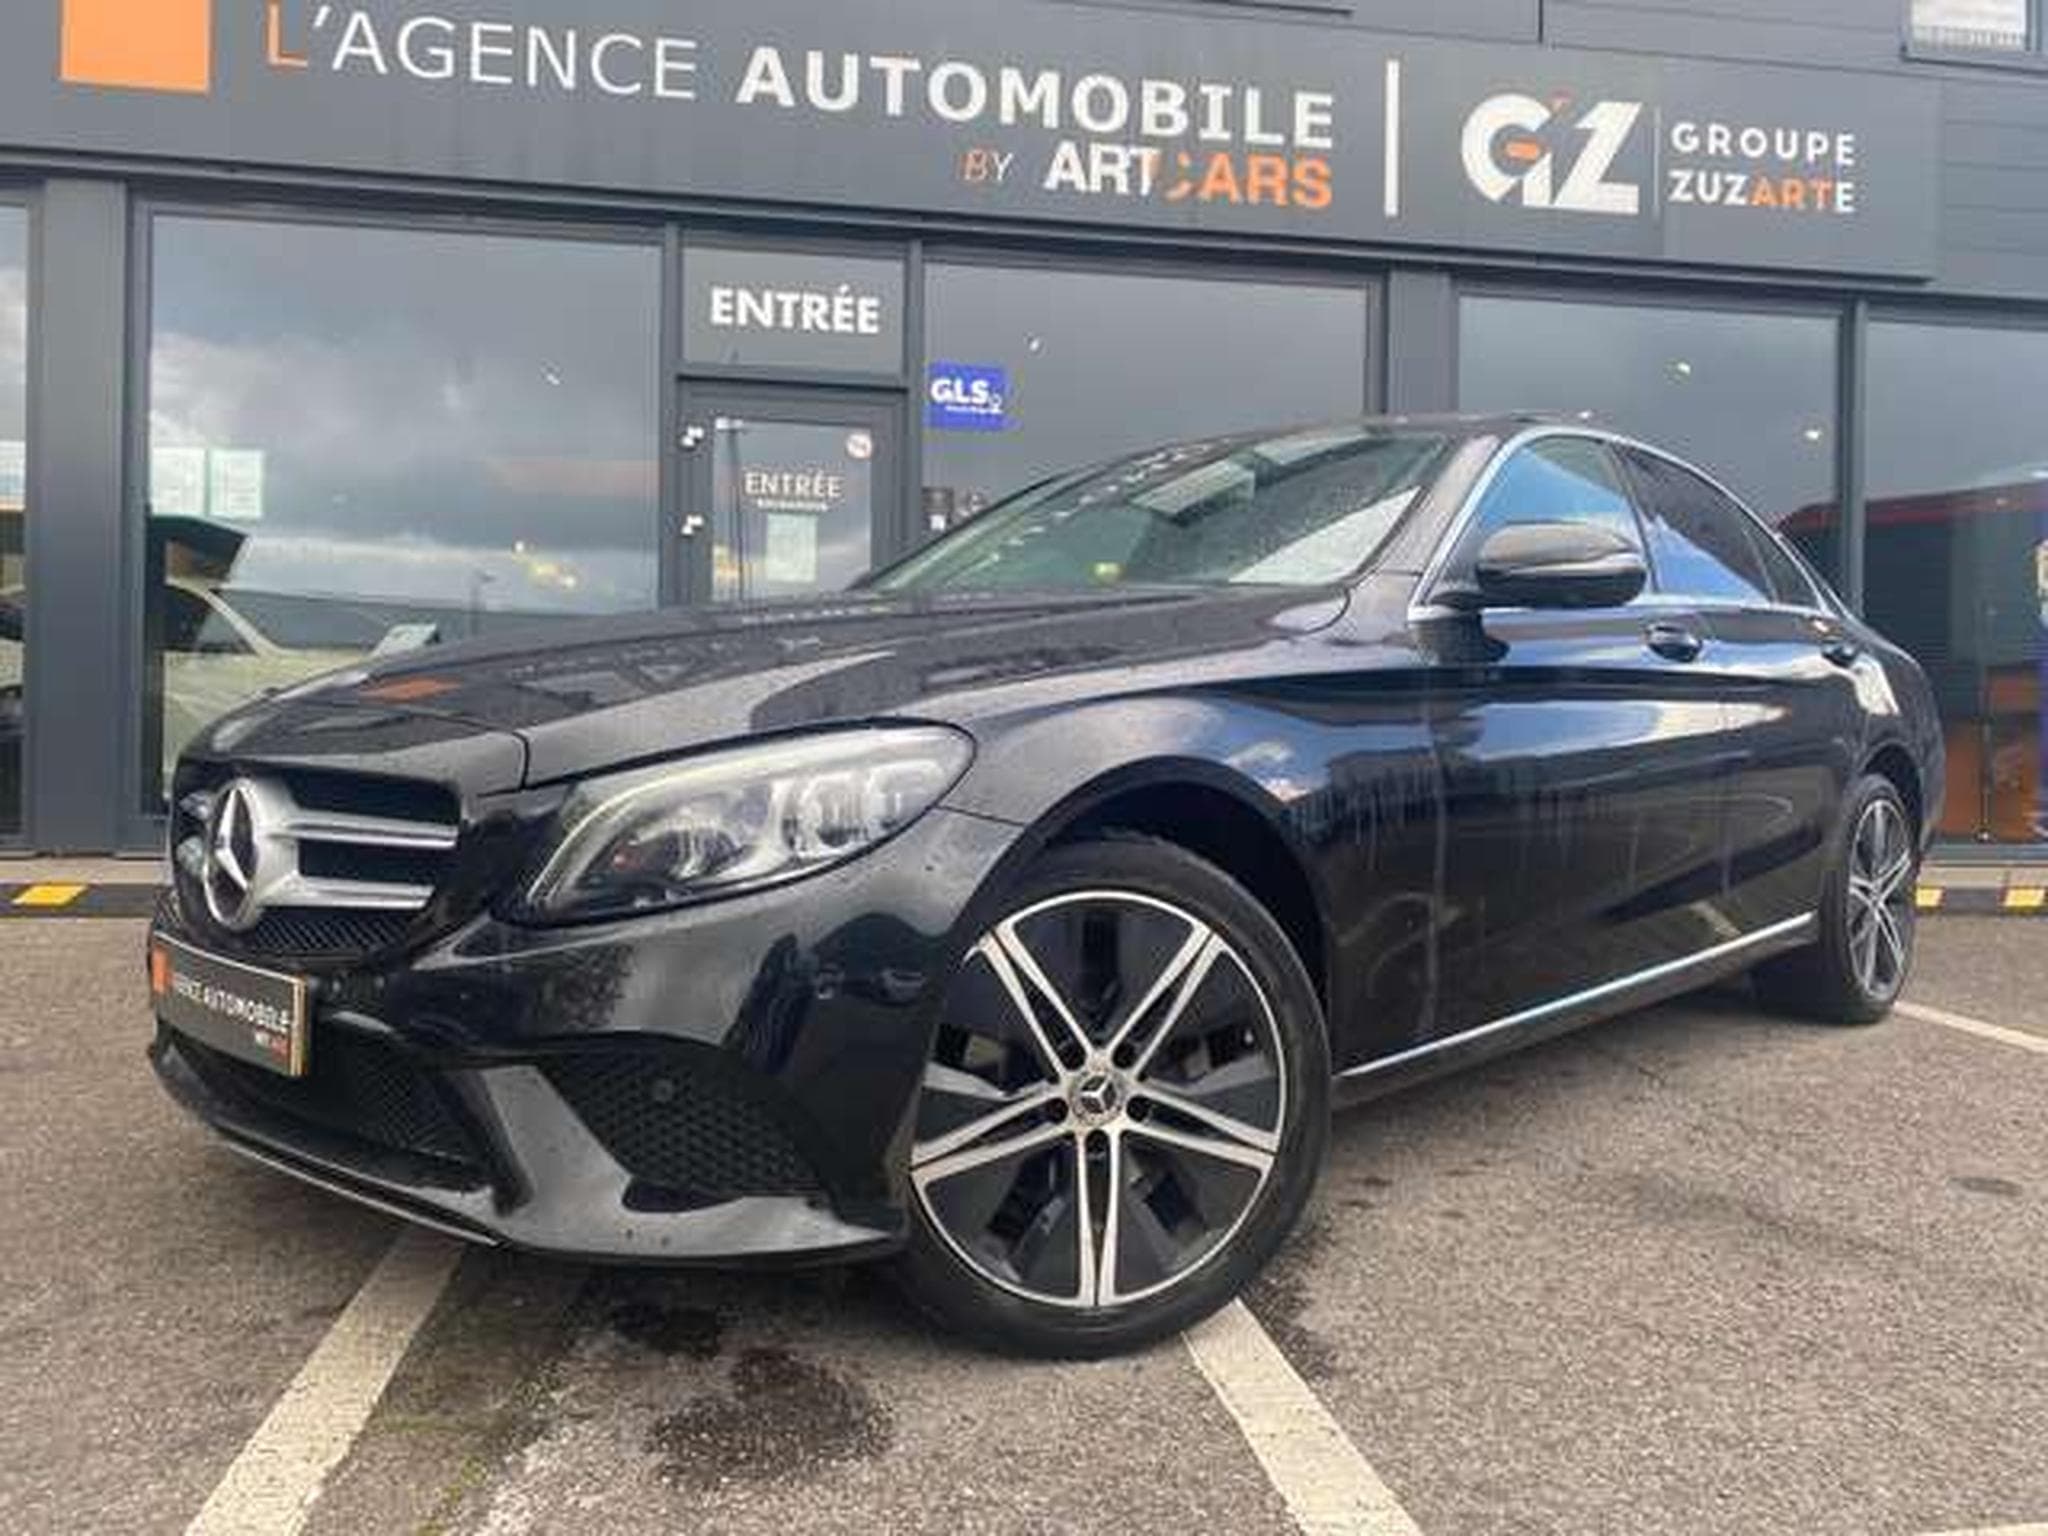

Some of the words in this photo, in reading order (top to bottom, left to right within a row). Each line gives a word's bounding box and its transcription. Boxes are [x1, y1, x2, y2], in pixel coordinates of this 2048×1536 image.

[265, 2, 697, 100] L'AGENCE
[735, 46, 1334, 149] AUTOMOBILE
[963, 149, 1014, 184] BY
[1670, 121, 1857, 167] GROUPE
[1667, 169, 1857, 214] ZUZARTE
[710, 284, 881, 335] ENTRÉE
[930, 376, 990, 405] GLS
[744, 471, 842, 499] ENTRÉE
